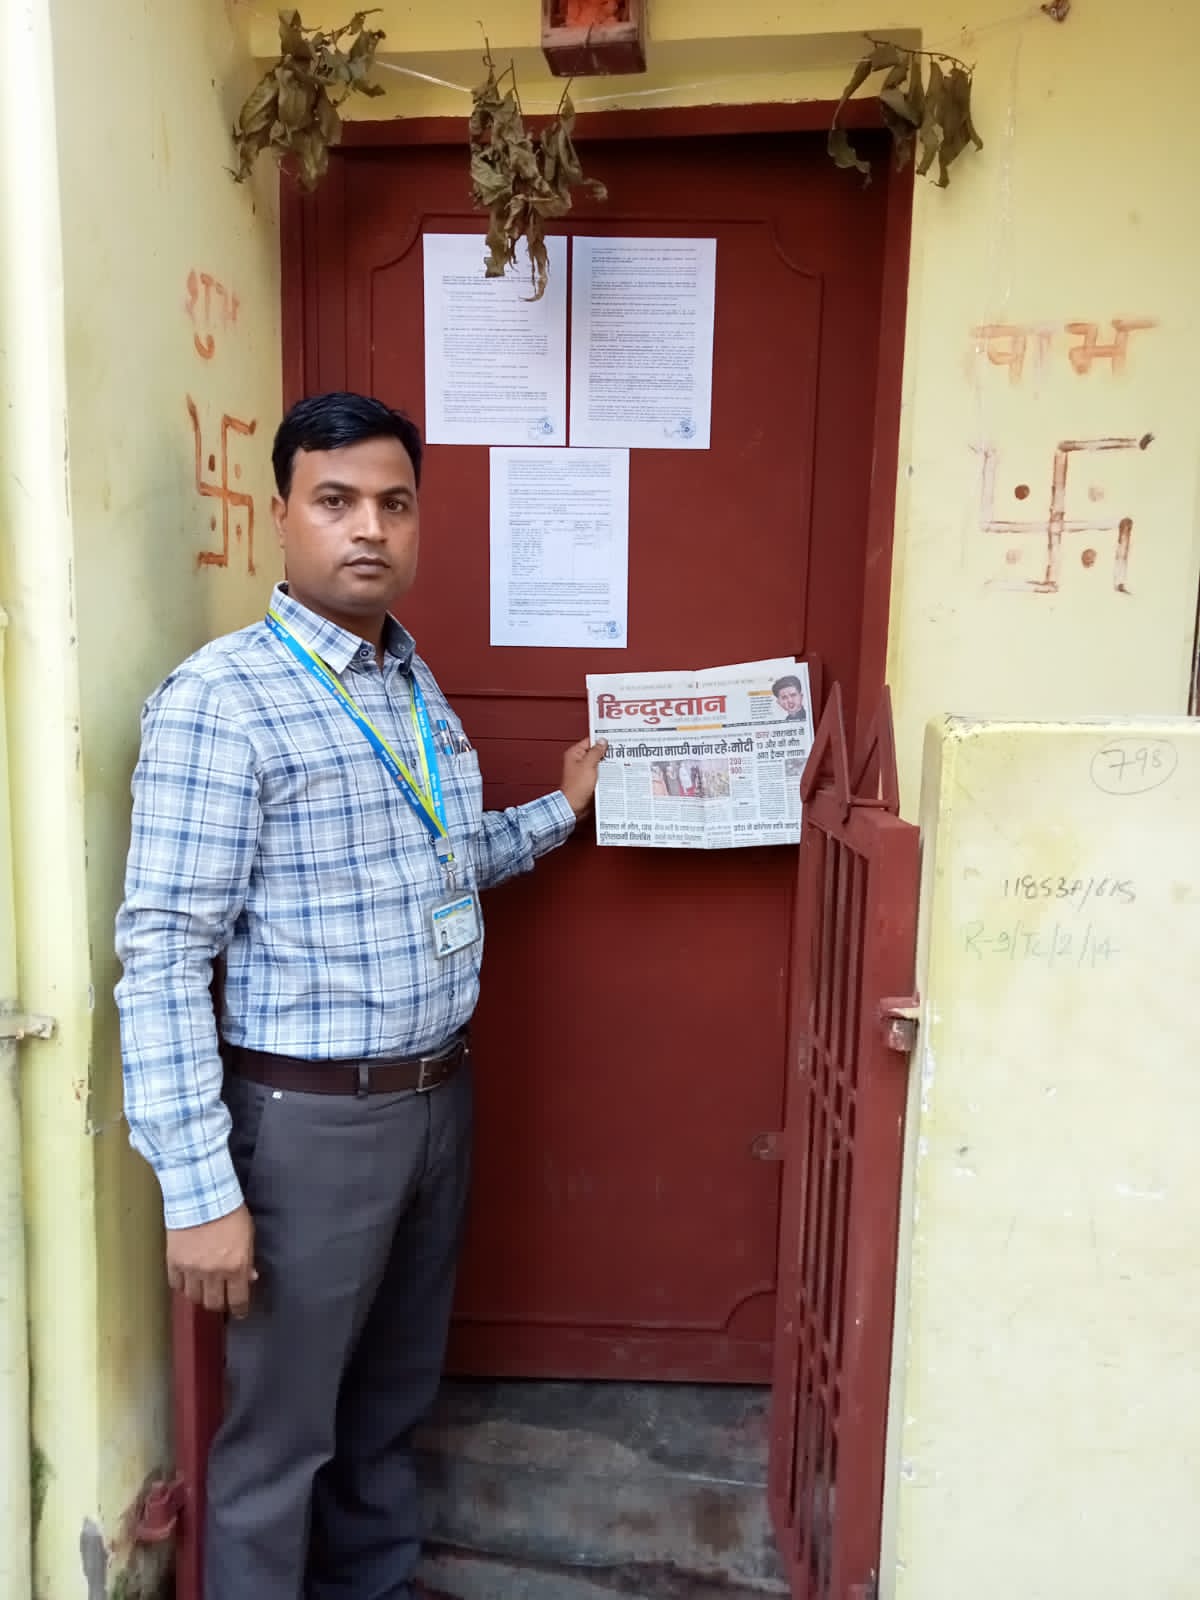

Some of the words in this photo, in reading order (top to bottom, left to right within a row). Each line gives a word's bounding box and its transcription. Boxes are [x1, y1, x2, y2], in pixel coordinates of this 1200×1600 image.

[596, 693, 728, 725] हिन्दुस्तान
[615, 743, 625, 759] में
[626, 743, 664, 758] माफिया
[664, 741, 690, 757] माफी
[691, 740, 713, 756] मांग
